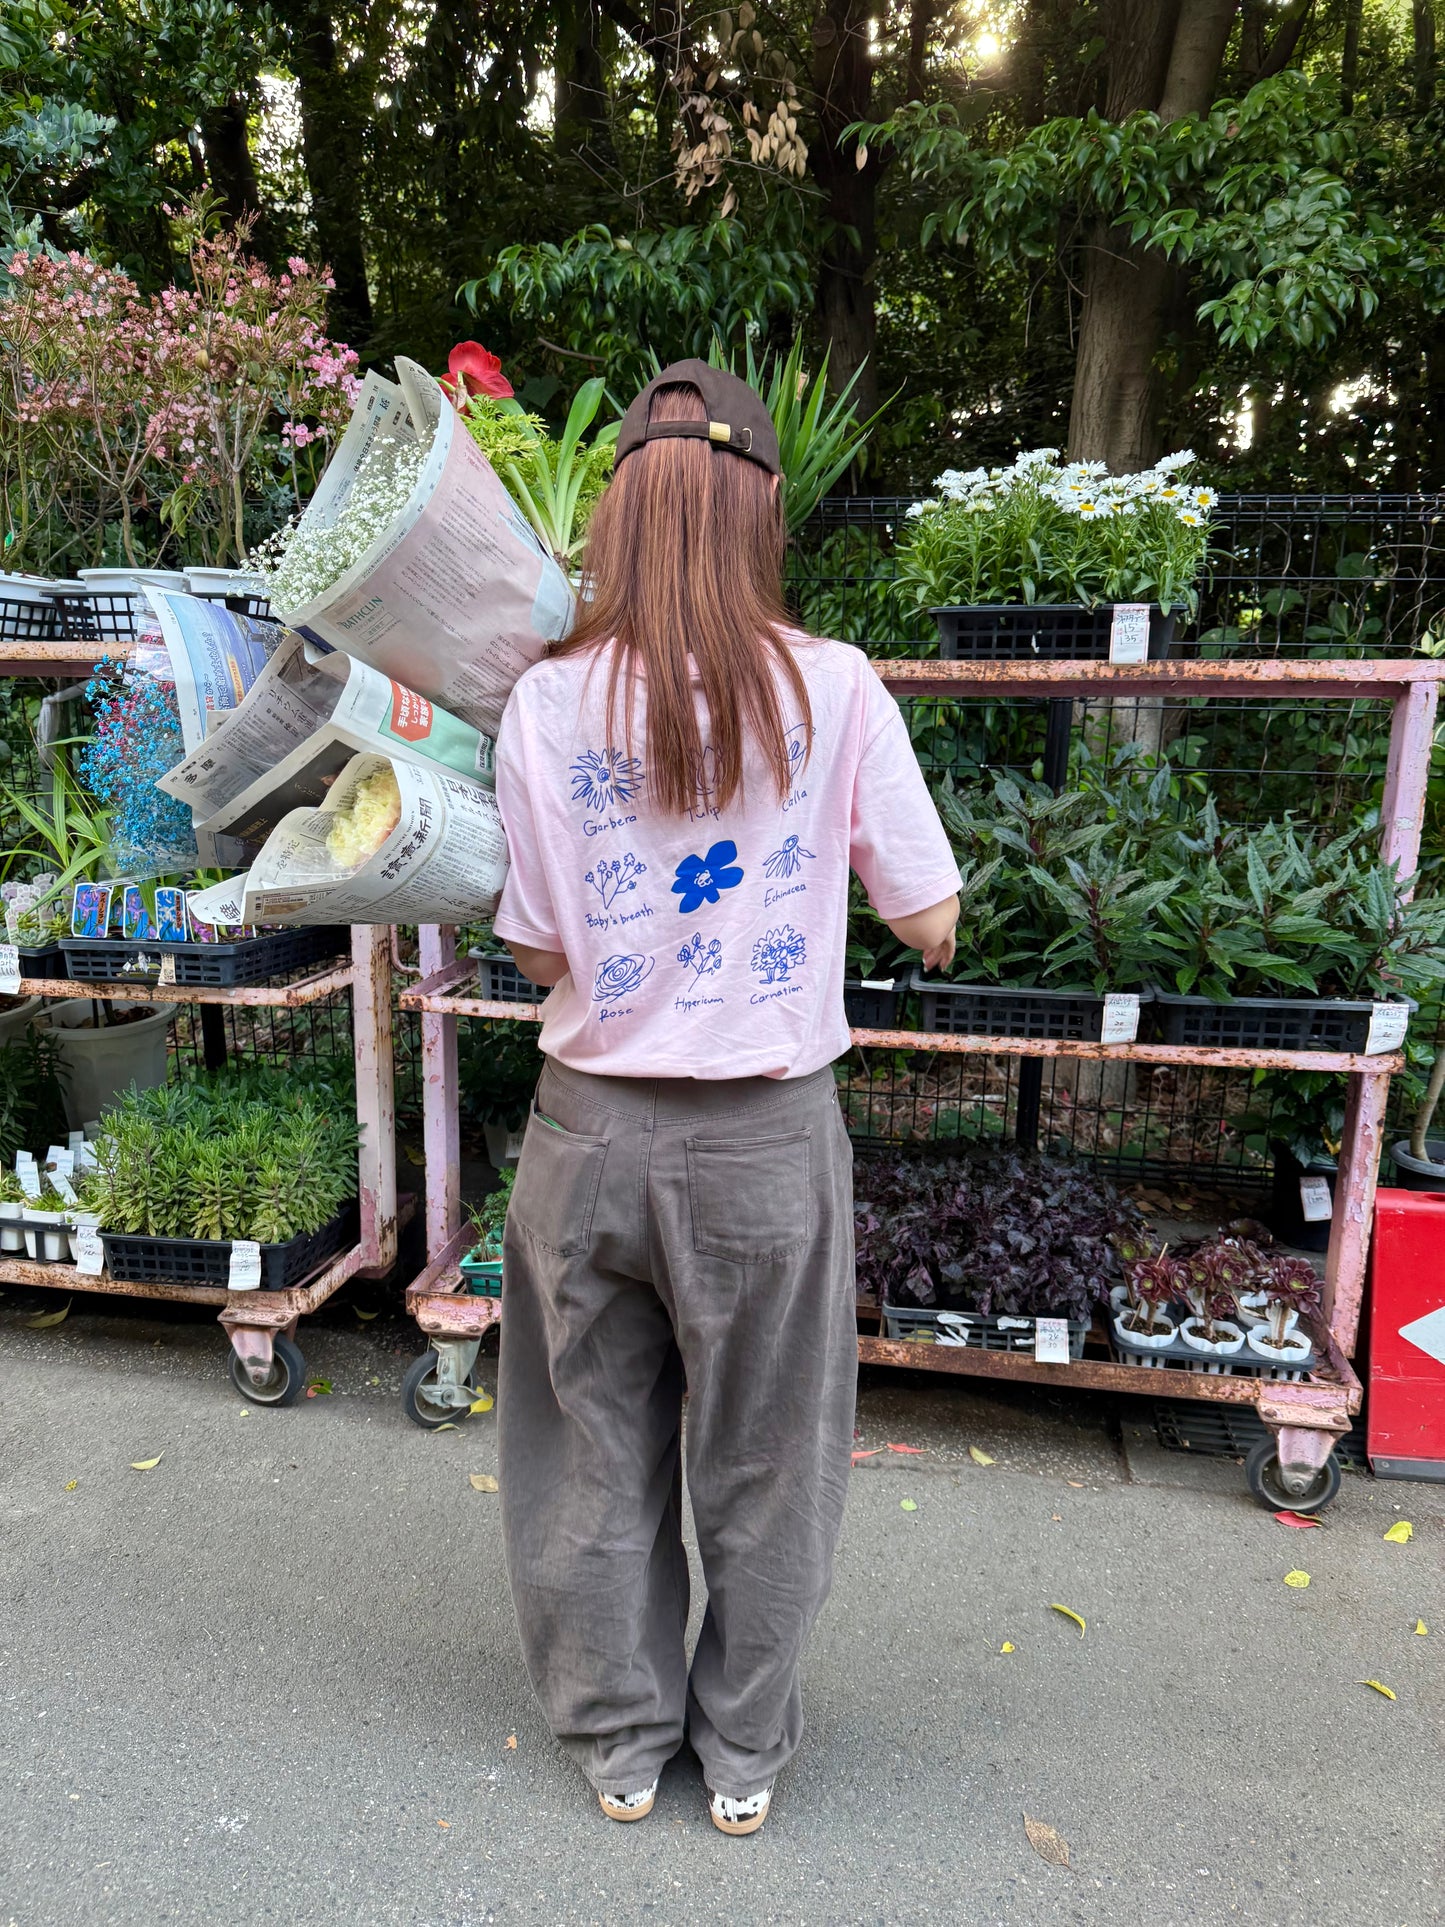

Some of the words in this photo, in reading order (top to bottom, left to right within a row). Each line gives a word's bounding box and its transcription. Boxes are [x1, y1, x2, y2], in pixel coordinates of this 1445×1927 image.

[336, 595, 384, 630] BATHCLIN
[782, 790, 807, 812] Calla
[764, 884, 806, 908] Echinacea
[585, 912, 618, 931] Baby's
[619, 903, 654, 925] breath
[675, 996, 724, 1013] Hypericum
[750, 985, 803, 1005] Carnation
[599, 1008, 634, 1023] Rose
